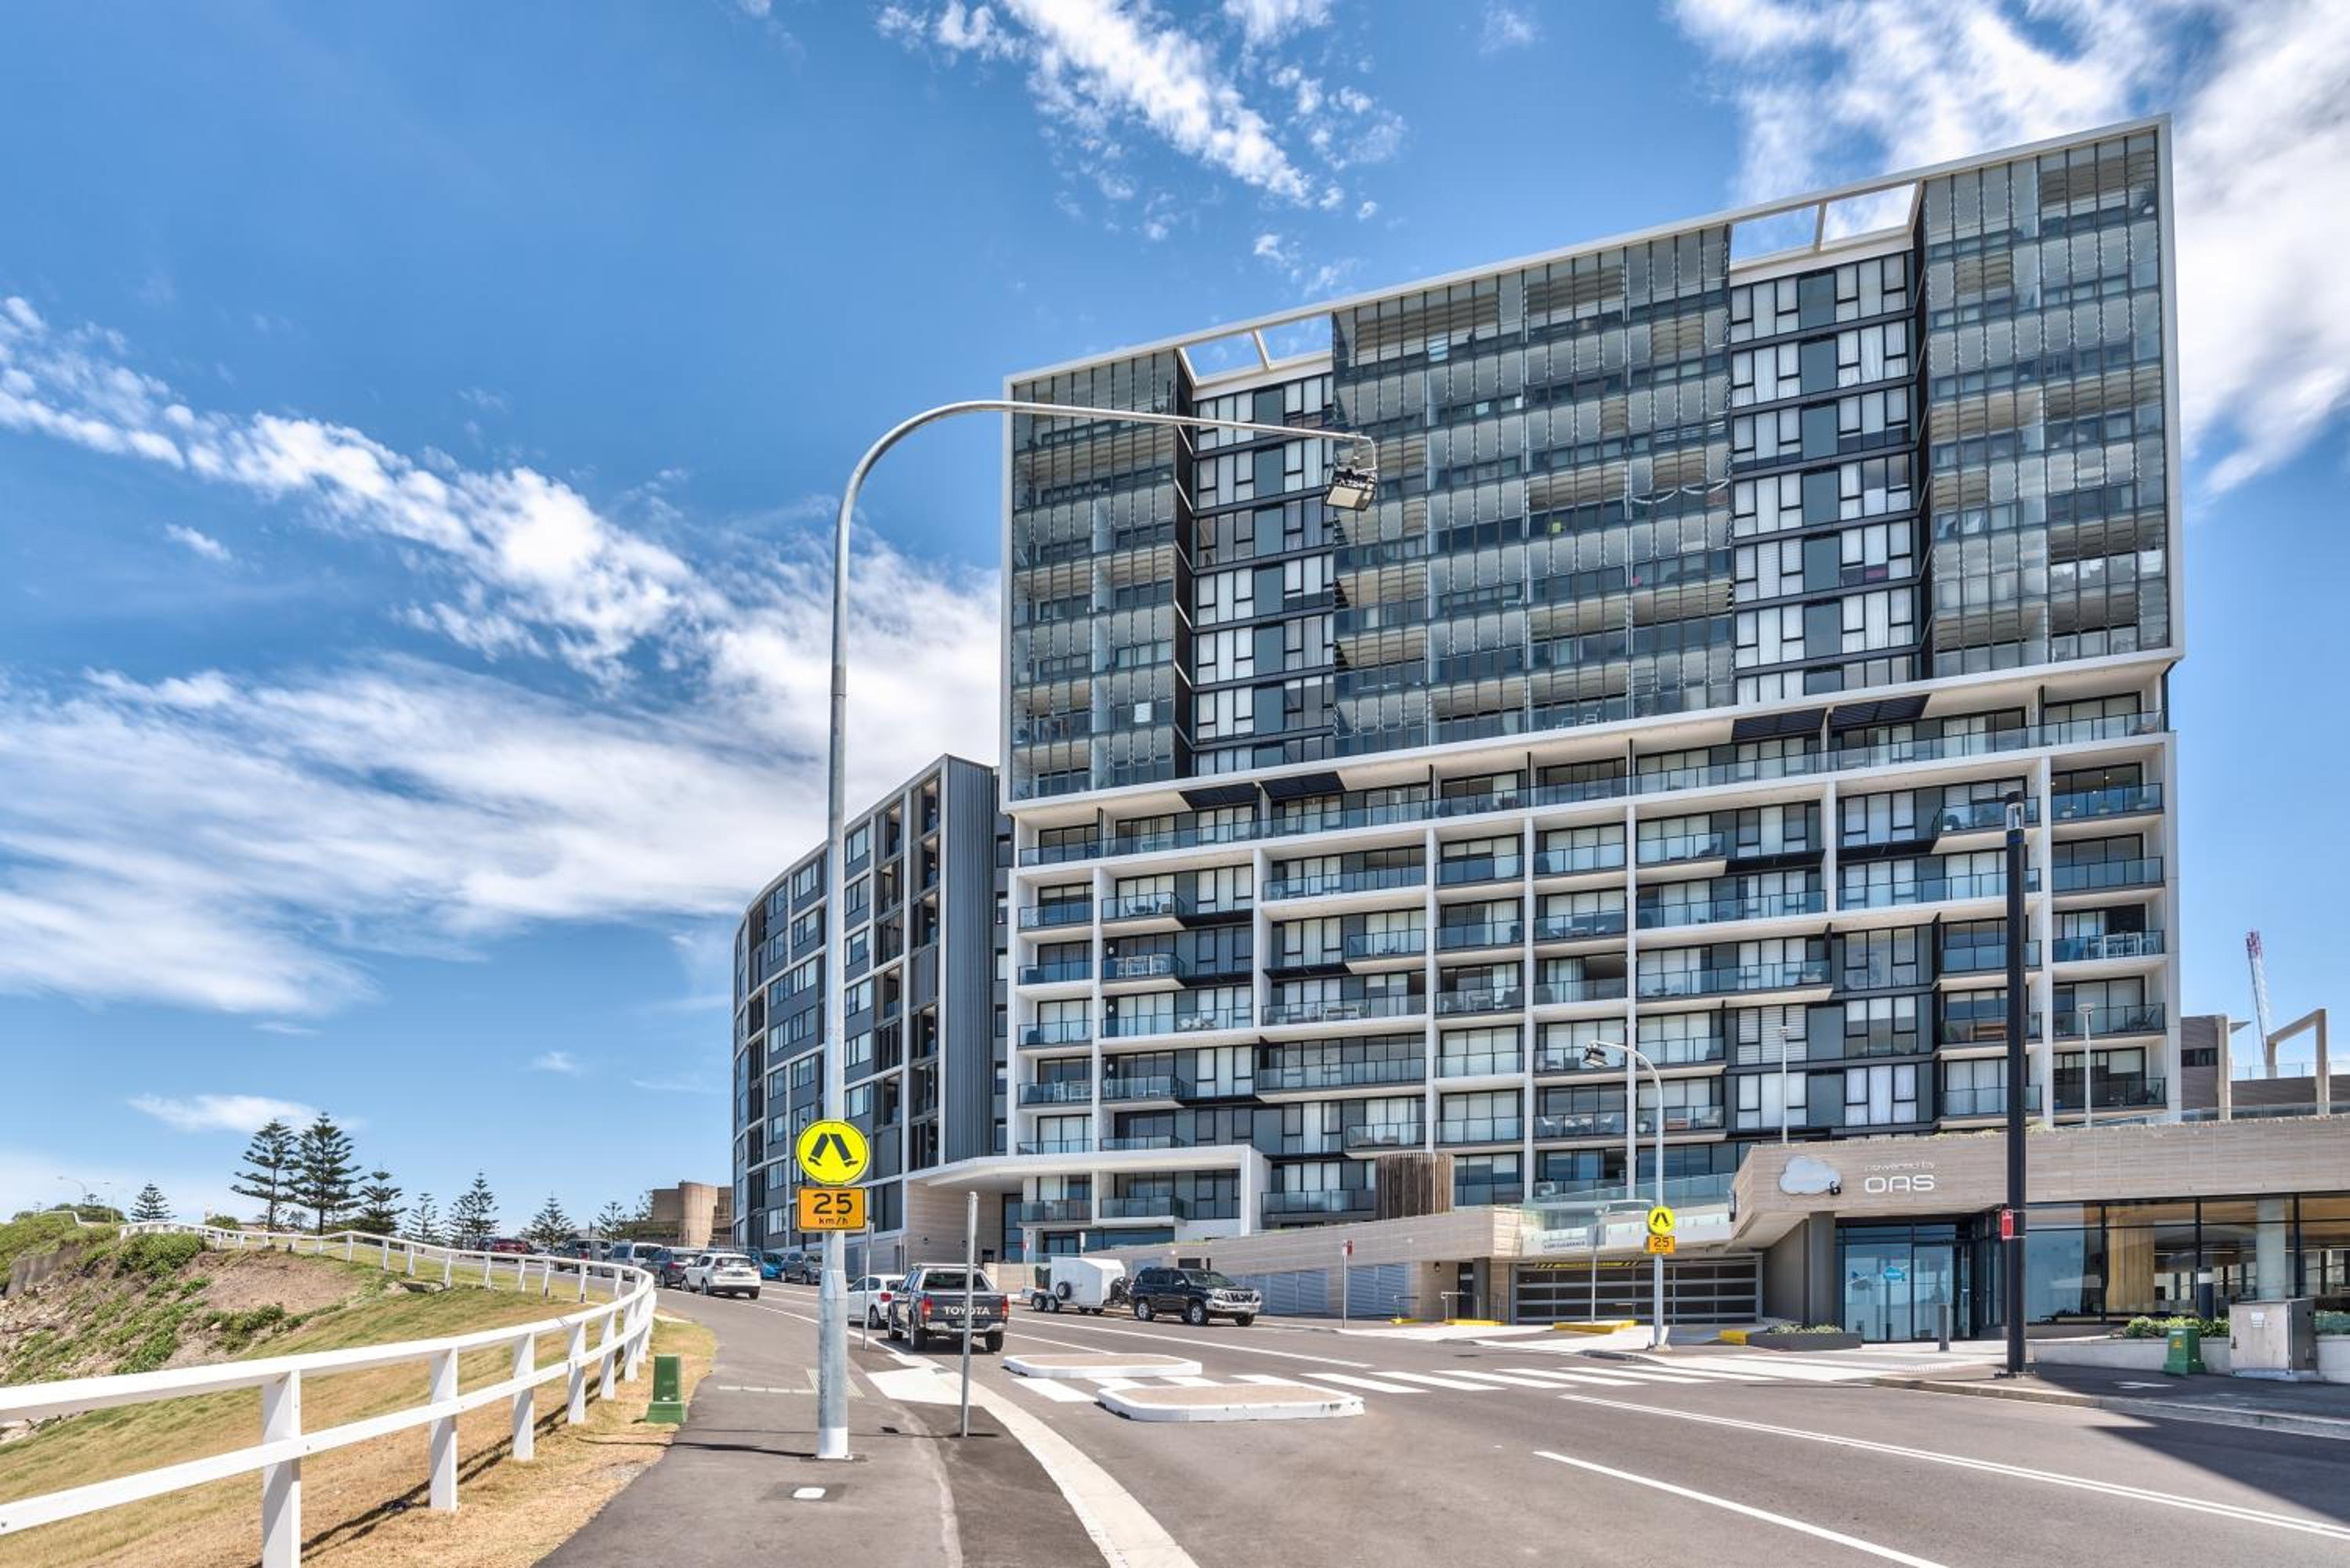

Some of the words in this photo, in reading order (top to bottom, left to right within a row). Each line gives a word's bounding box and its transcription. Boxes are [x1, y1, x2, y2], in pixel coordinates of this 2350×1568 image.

[1865, 1175, 1934, 1192] OAS
[813, 1193, 852, 1214] 25
[819, 1217, 848, 1226] km/h
[1654, 1237, 1669, 1248] 25
[943, 1306, 991, 1315] TOYOTA
